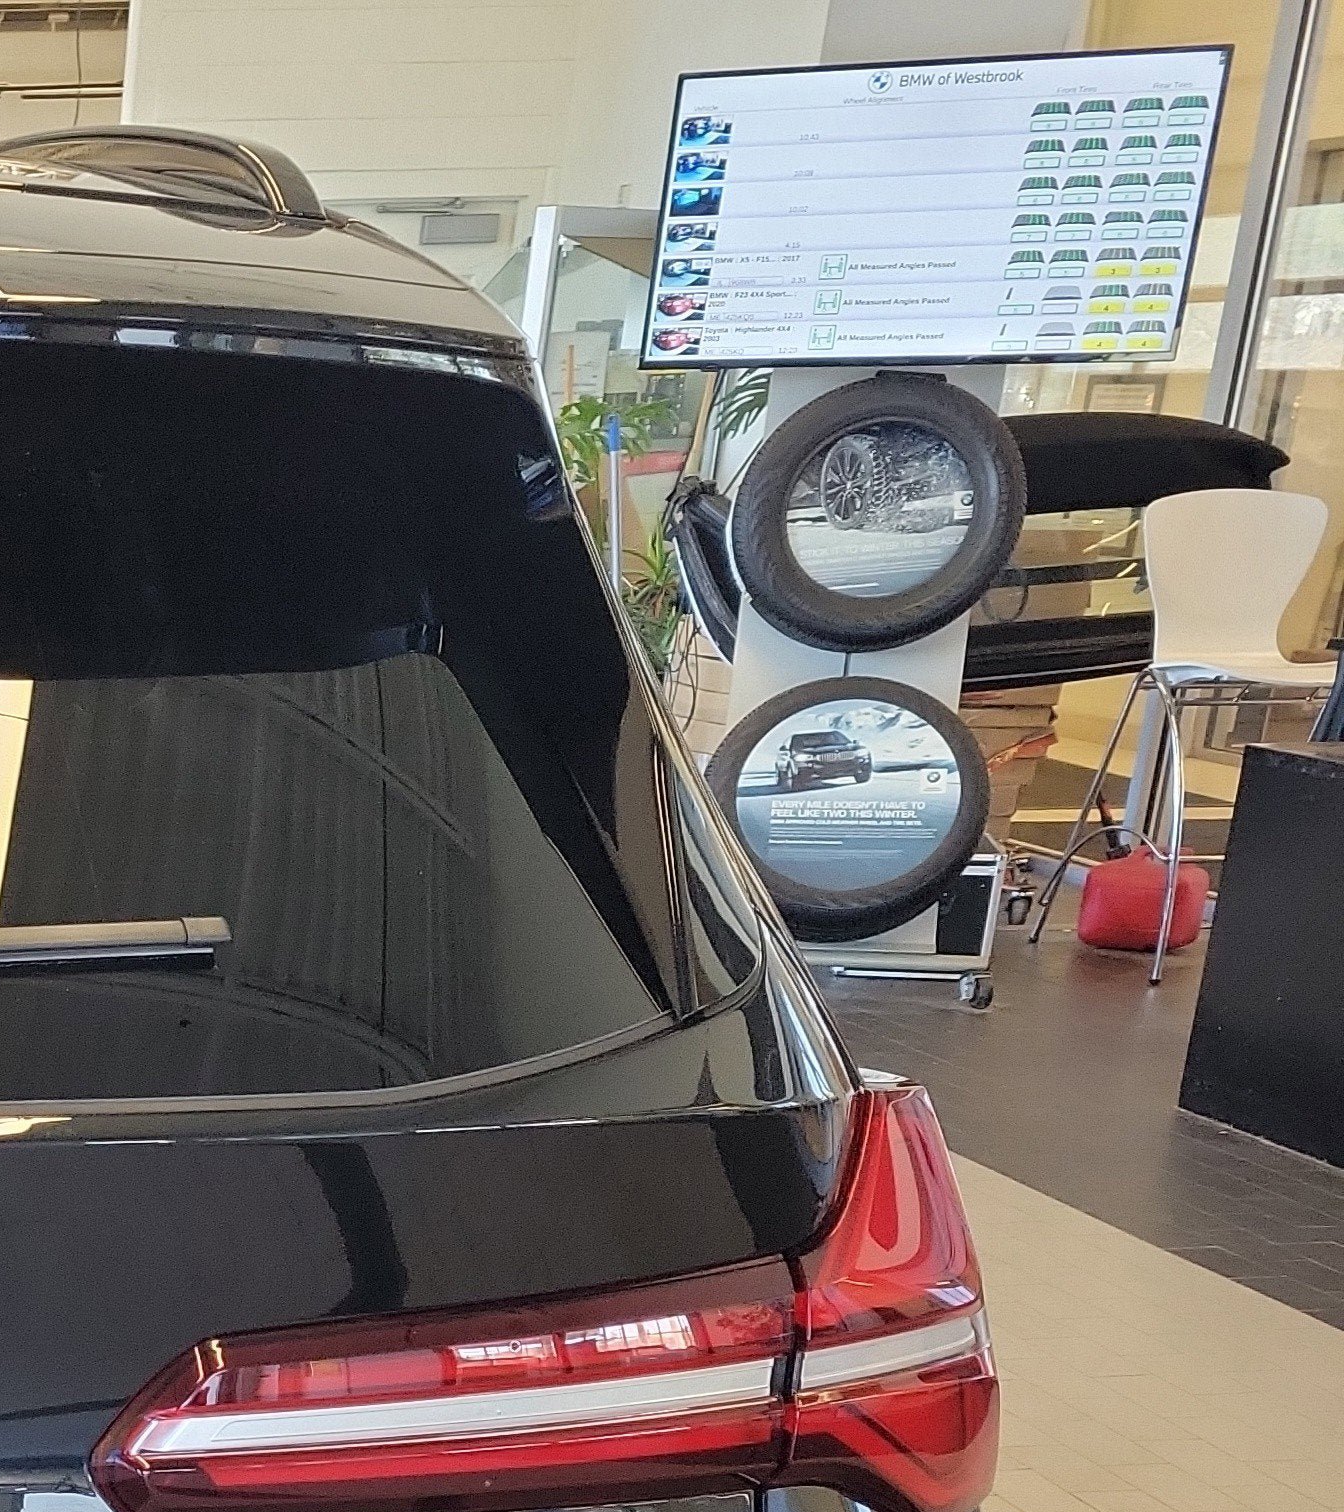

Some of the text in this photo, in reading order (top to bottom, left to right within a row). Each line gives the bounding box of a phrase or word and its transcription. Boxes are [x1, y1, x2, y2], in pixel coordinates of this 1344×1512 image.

[899, 74, 935, 87] BMW
[938, 72, 951, 85] of
[954, 69, 1024, 85] Westbrook
[899, 262, 926, 270] Angles
[855, 298, 892, 306] Measured
[893, 298, 920, 306] Angles
[734, 326, 774, 334] Highlander
[836, 334, 847, 342] All
[887, 334, 914, 342] Angles
[772, 800, 926, 810] EVERY MILE DOESN'T HAVE TO
[770, 810, 918, 819] FEEL LIKE TWO THIS WINTER.
